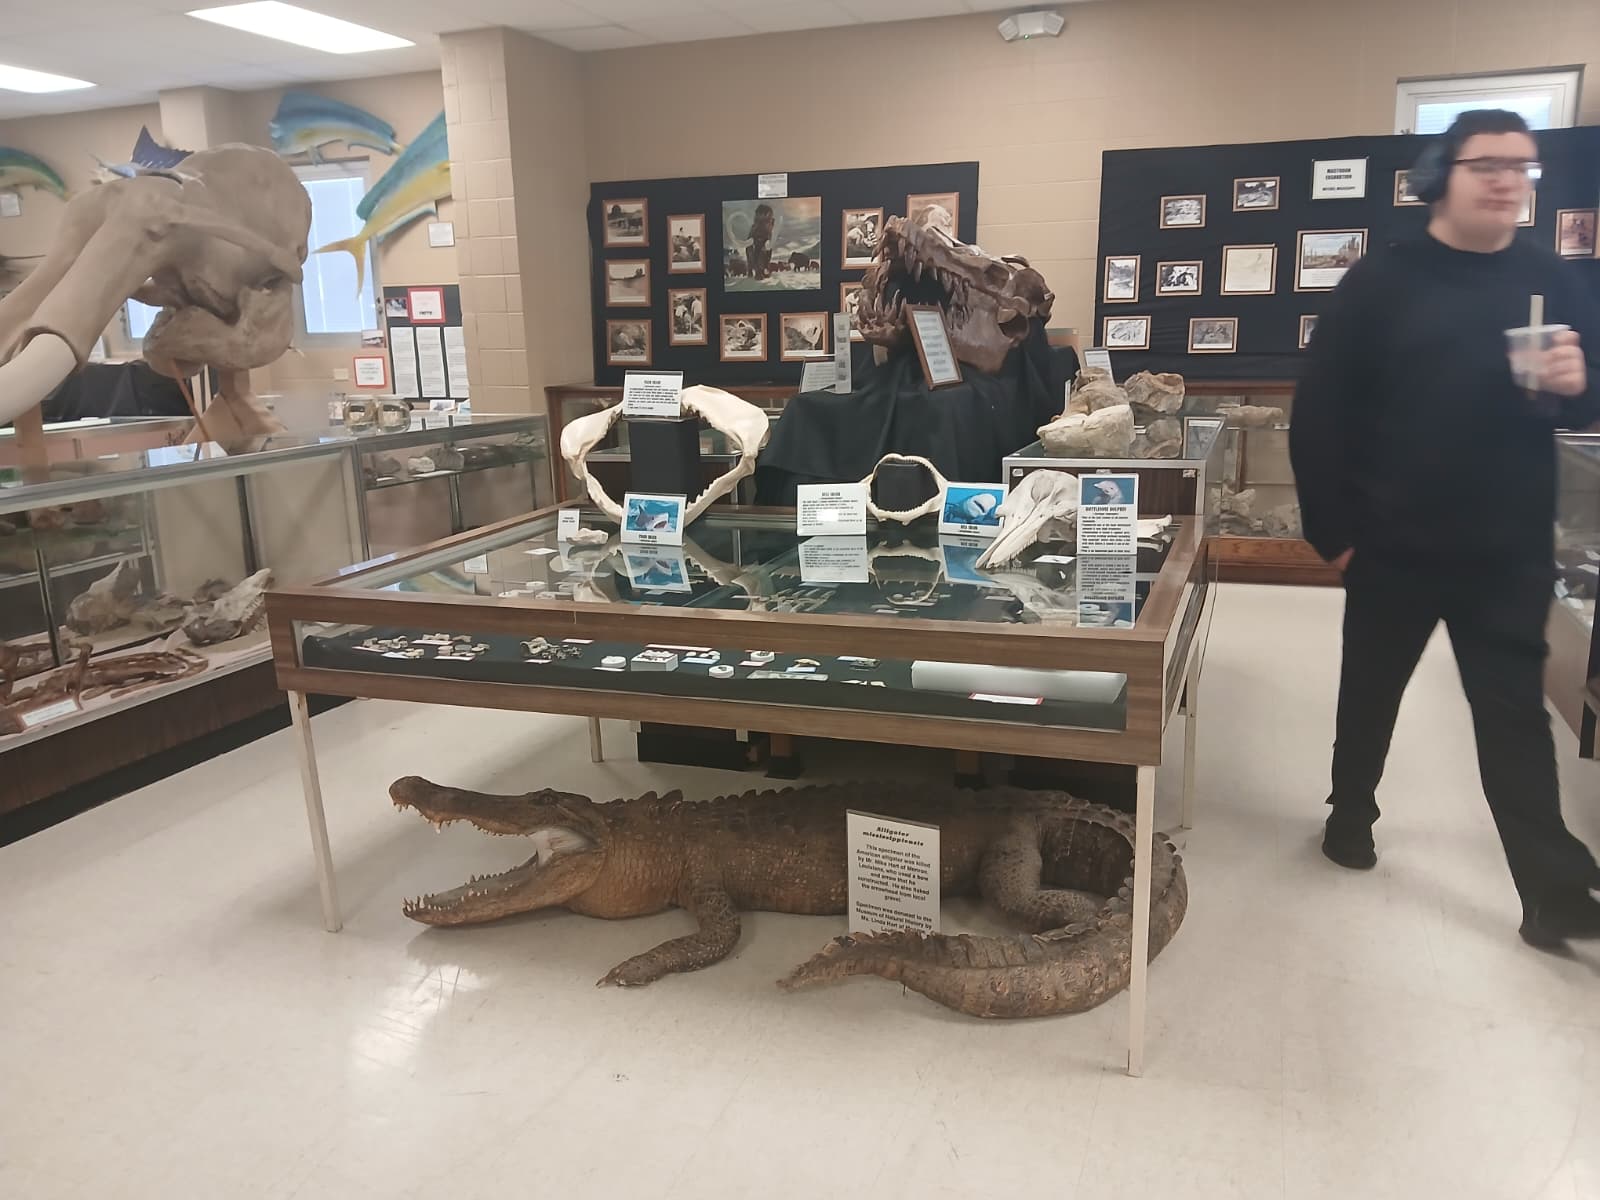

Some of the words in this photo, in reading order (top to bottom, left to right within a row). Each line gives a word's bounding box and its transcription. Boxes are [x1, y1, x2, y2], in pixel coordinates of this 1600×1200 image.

[856, 849, 880, 858] American
[882, 855, 902, 863] alligator
[878, 847, 903, 856] specimen
[856, 901, 881, 911] Specimen
[894, 909, 915, 918] donated
[856, 907, 877, 916] Museum
[885, 914, 904, 923] Natural
